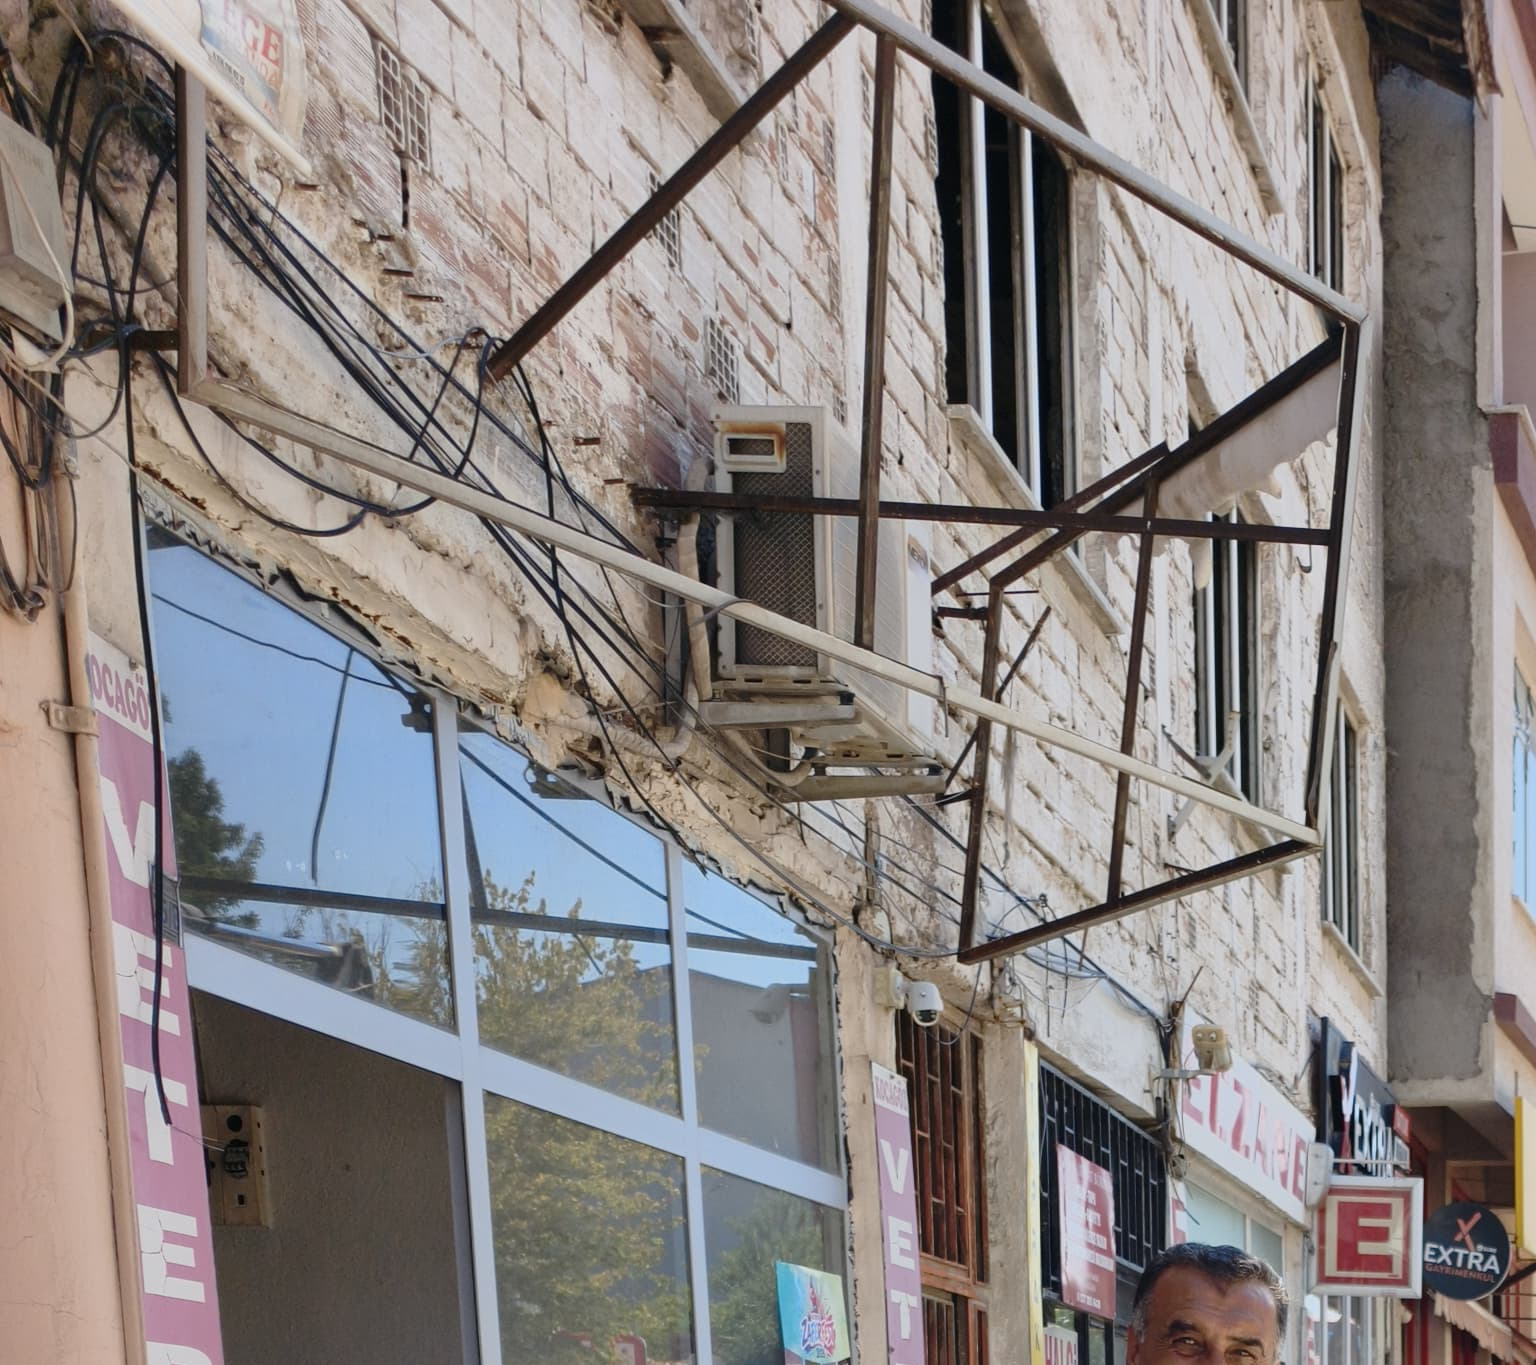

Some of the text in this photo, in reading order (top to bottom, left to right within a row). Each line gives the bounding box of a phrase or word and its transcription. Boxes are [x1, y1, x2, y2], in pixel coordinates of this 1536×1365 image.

[88, 654, 150, 731] OCAGÖ
[1337, 1202, 1393, 1273] E
[1424, 1242, 1500, 1275] EXTRA
